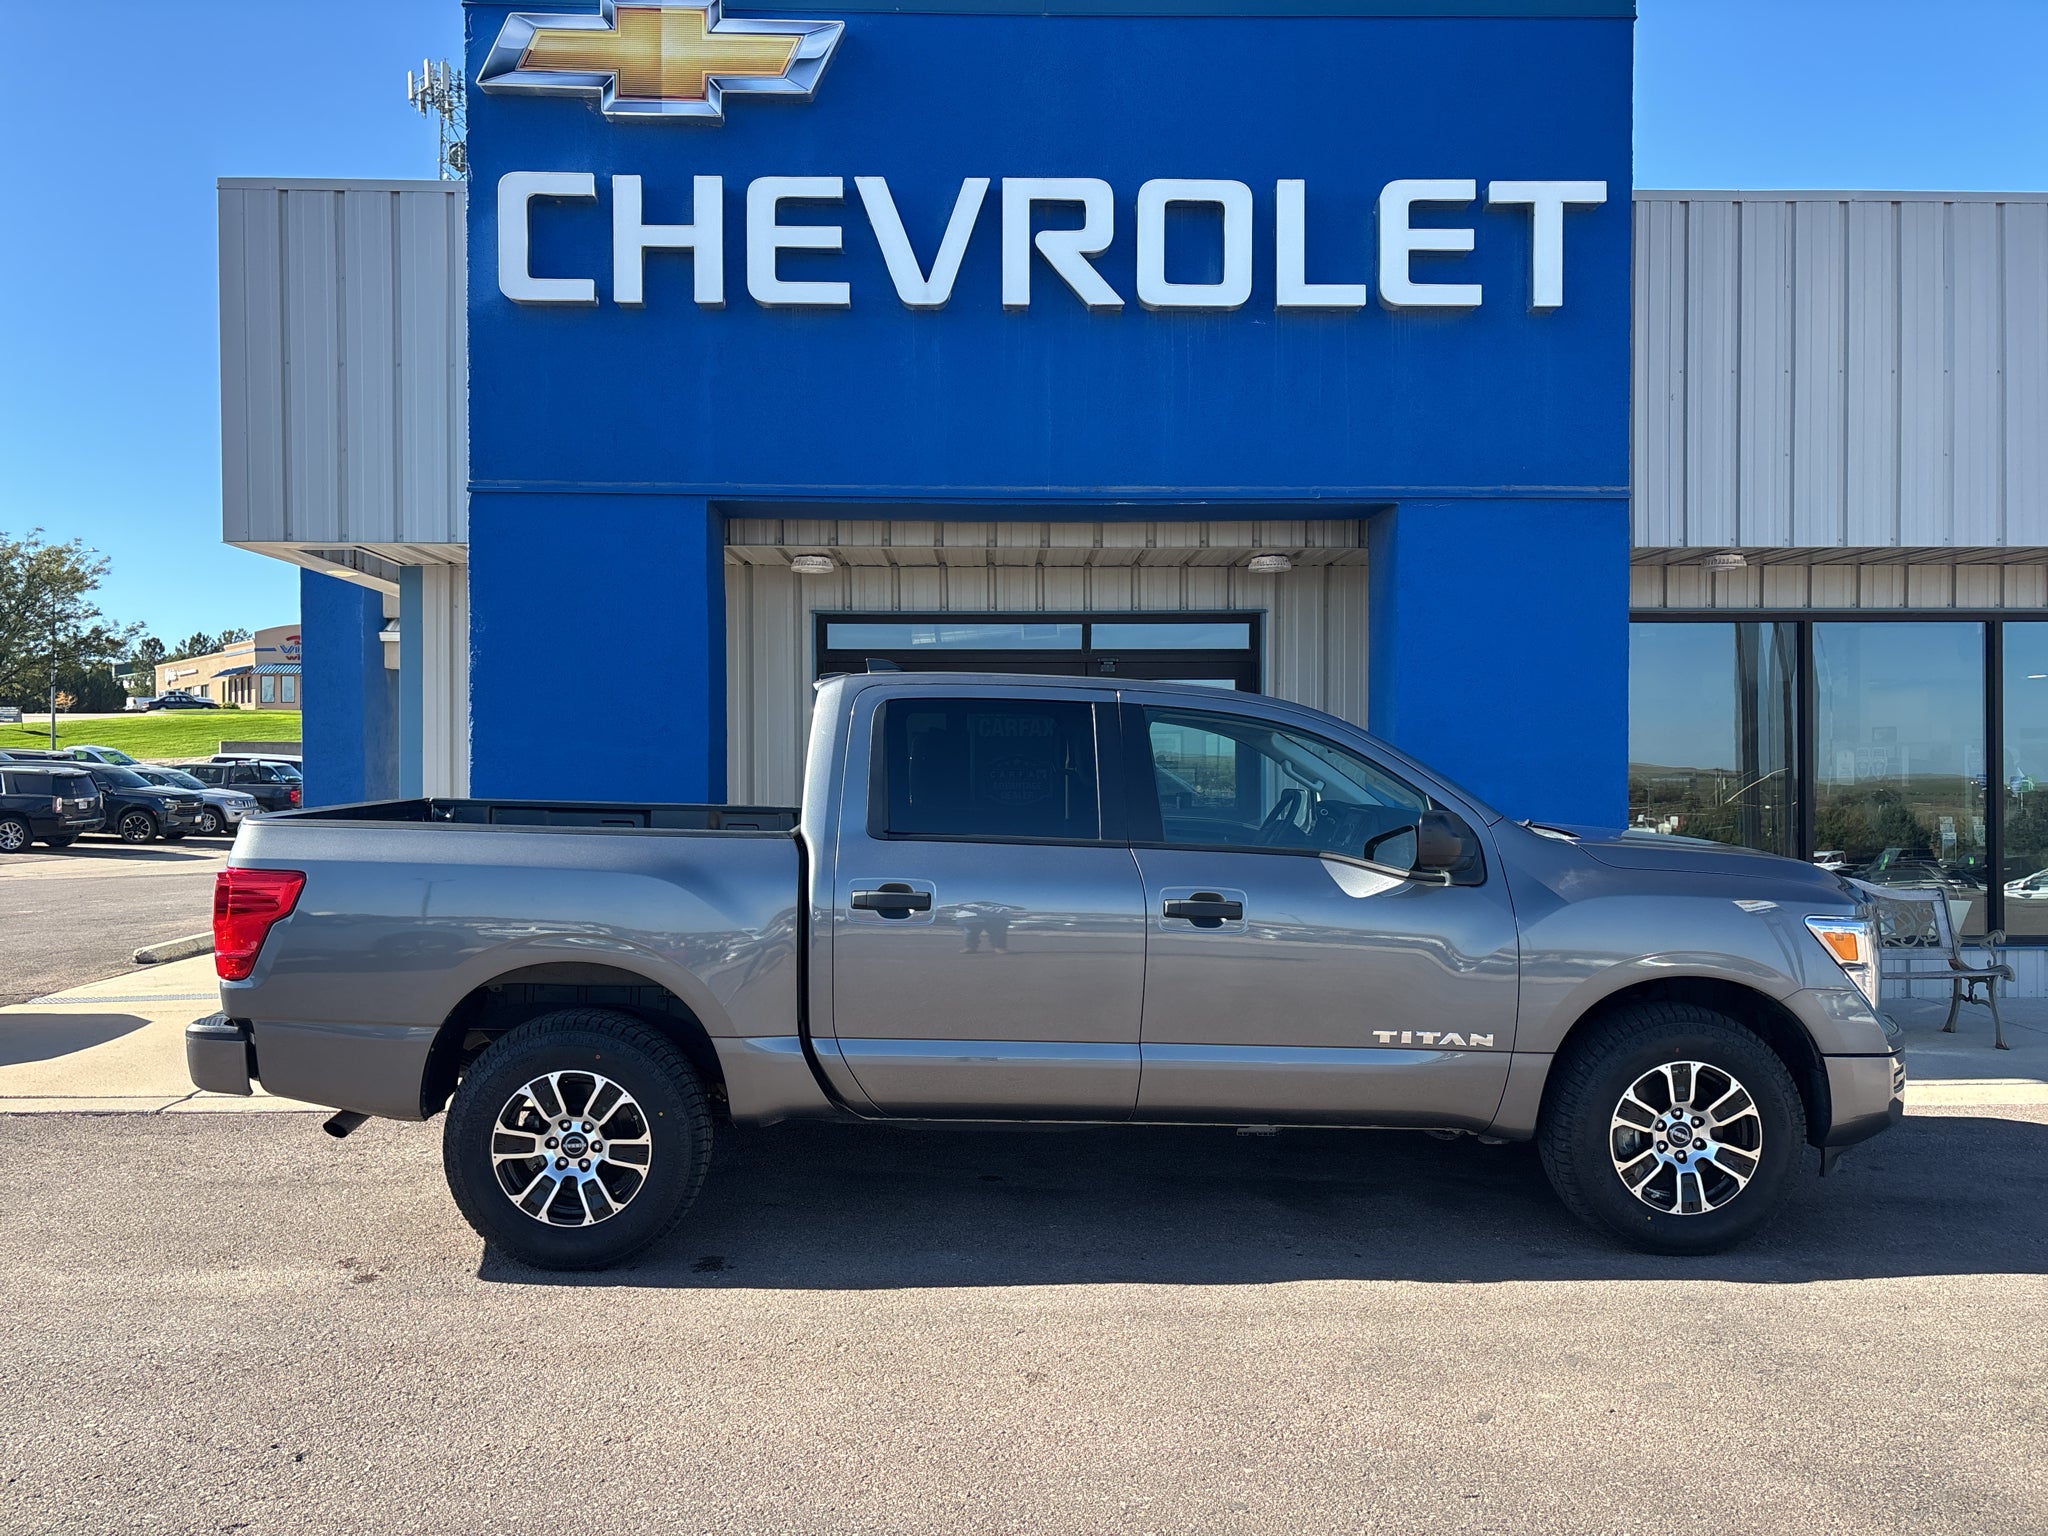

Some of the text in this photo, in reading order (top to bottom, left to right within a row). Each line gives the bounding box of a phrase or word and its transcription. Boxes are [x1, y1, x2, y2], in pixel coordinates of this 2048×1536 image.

[497, 171, 1607, 308] CHEVROLET
[979, 718, 1055, 737] CARFAX
[1372, 1030, 1494, 1047] TITAN
